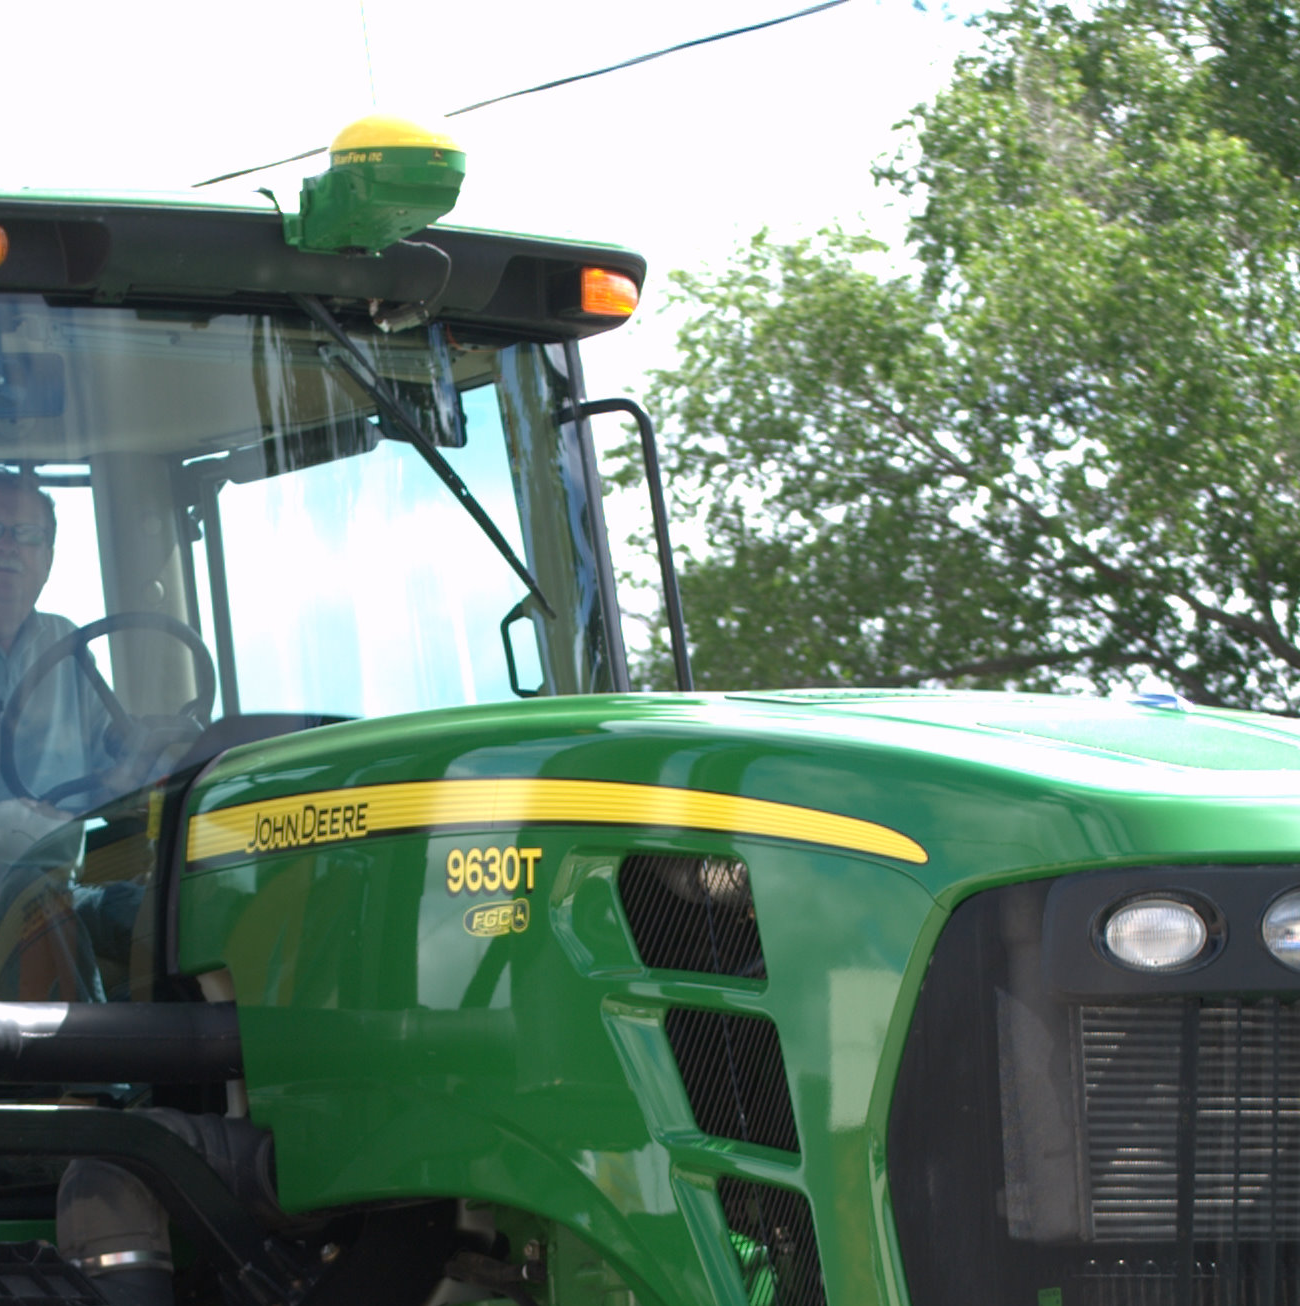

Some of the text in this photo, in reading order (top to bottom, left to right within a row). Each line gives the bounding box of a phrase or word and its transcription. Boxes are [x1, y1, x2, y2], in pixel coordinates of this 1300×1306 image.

[248, 803, 368, 847] JOHN DEERE
[446, 846, 542, 894] 9630T
[472, 908, 513, 929] FGC
